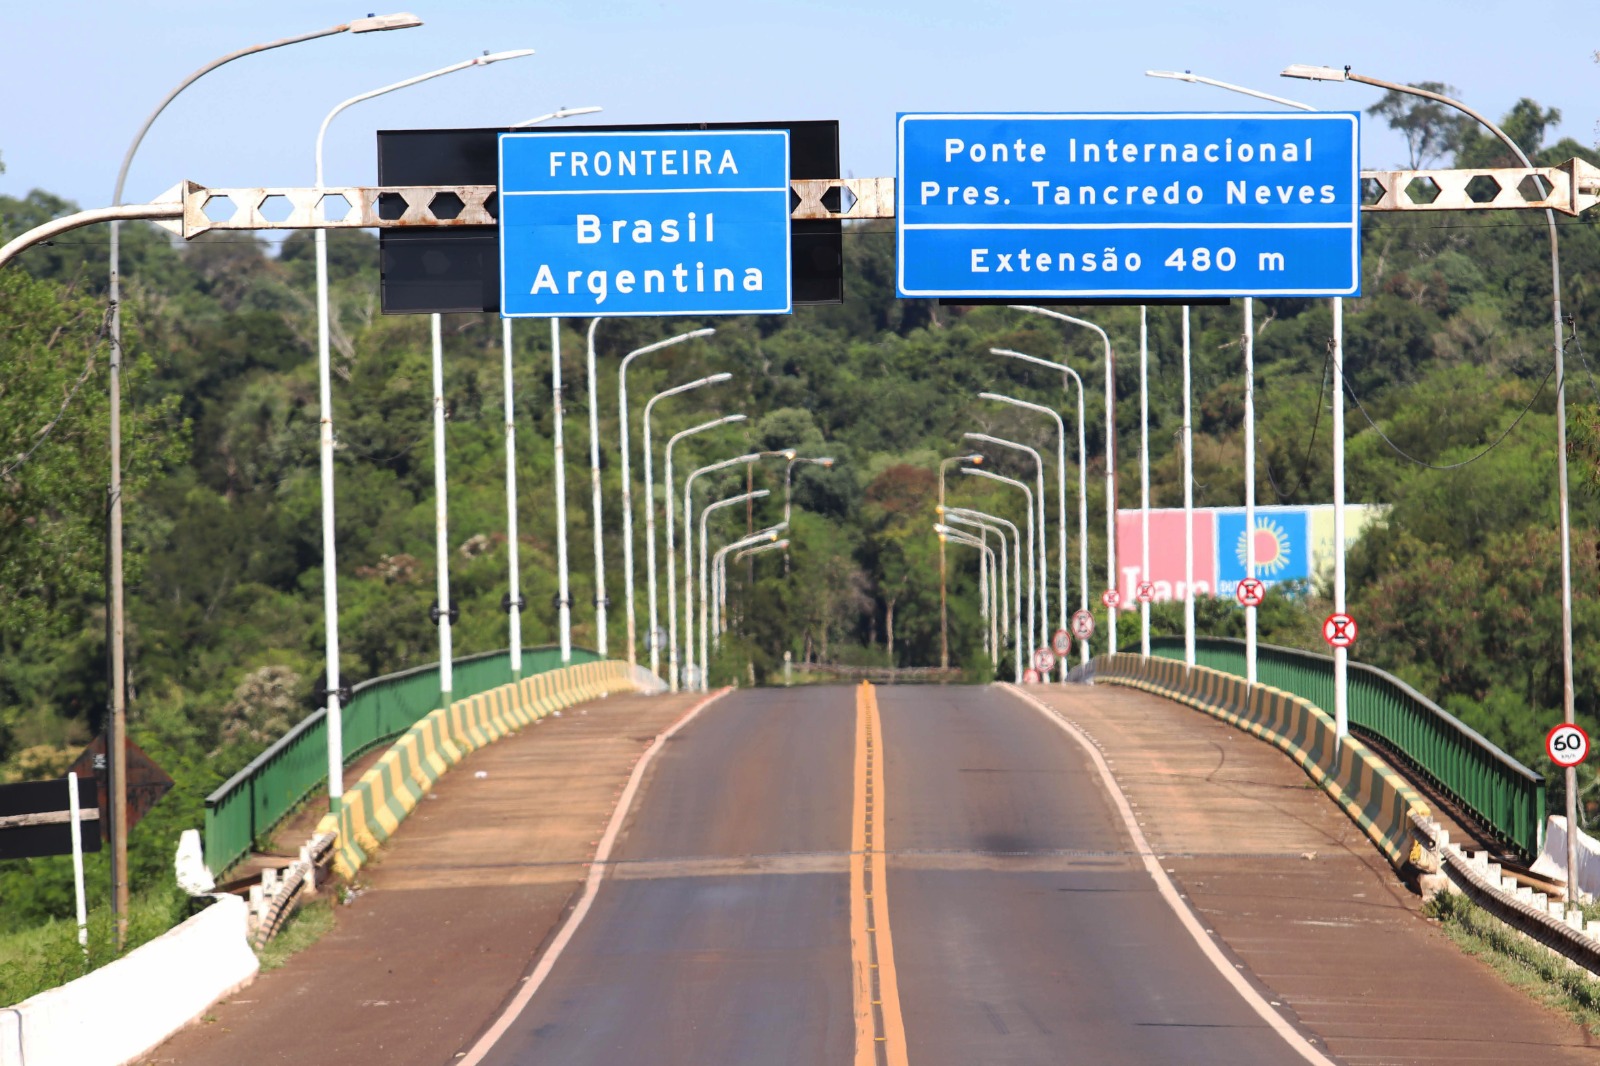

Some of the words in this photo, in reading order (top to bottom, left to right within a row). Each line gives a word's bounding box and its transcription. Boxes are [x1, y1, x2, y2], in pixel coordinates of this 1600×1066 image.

[549, 149, 739, 177] FRONTEIRA
[945, 138, 1046, 163] Ponte
[1069, 137, 1312, 163] Internacional
[921, 181, 1010, 205] Pres.
[1031, 180, 1203, 205] Tancredo
[1226, 180, 1336, 205] Neves
[576, 211, 714, 244] Brasil
[971, 247, 1142, 272] Extensão
[1164, 247, 1237, 272] 480
[1258, 252, 1285, 271] m
[530, 261, 763, 304] Argentina
[1554, 733, 1581, 751] 60
